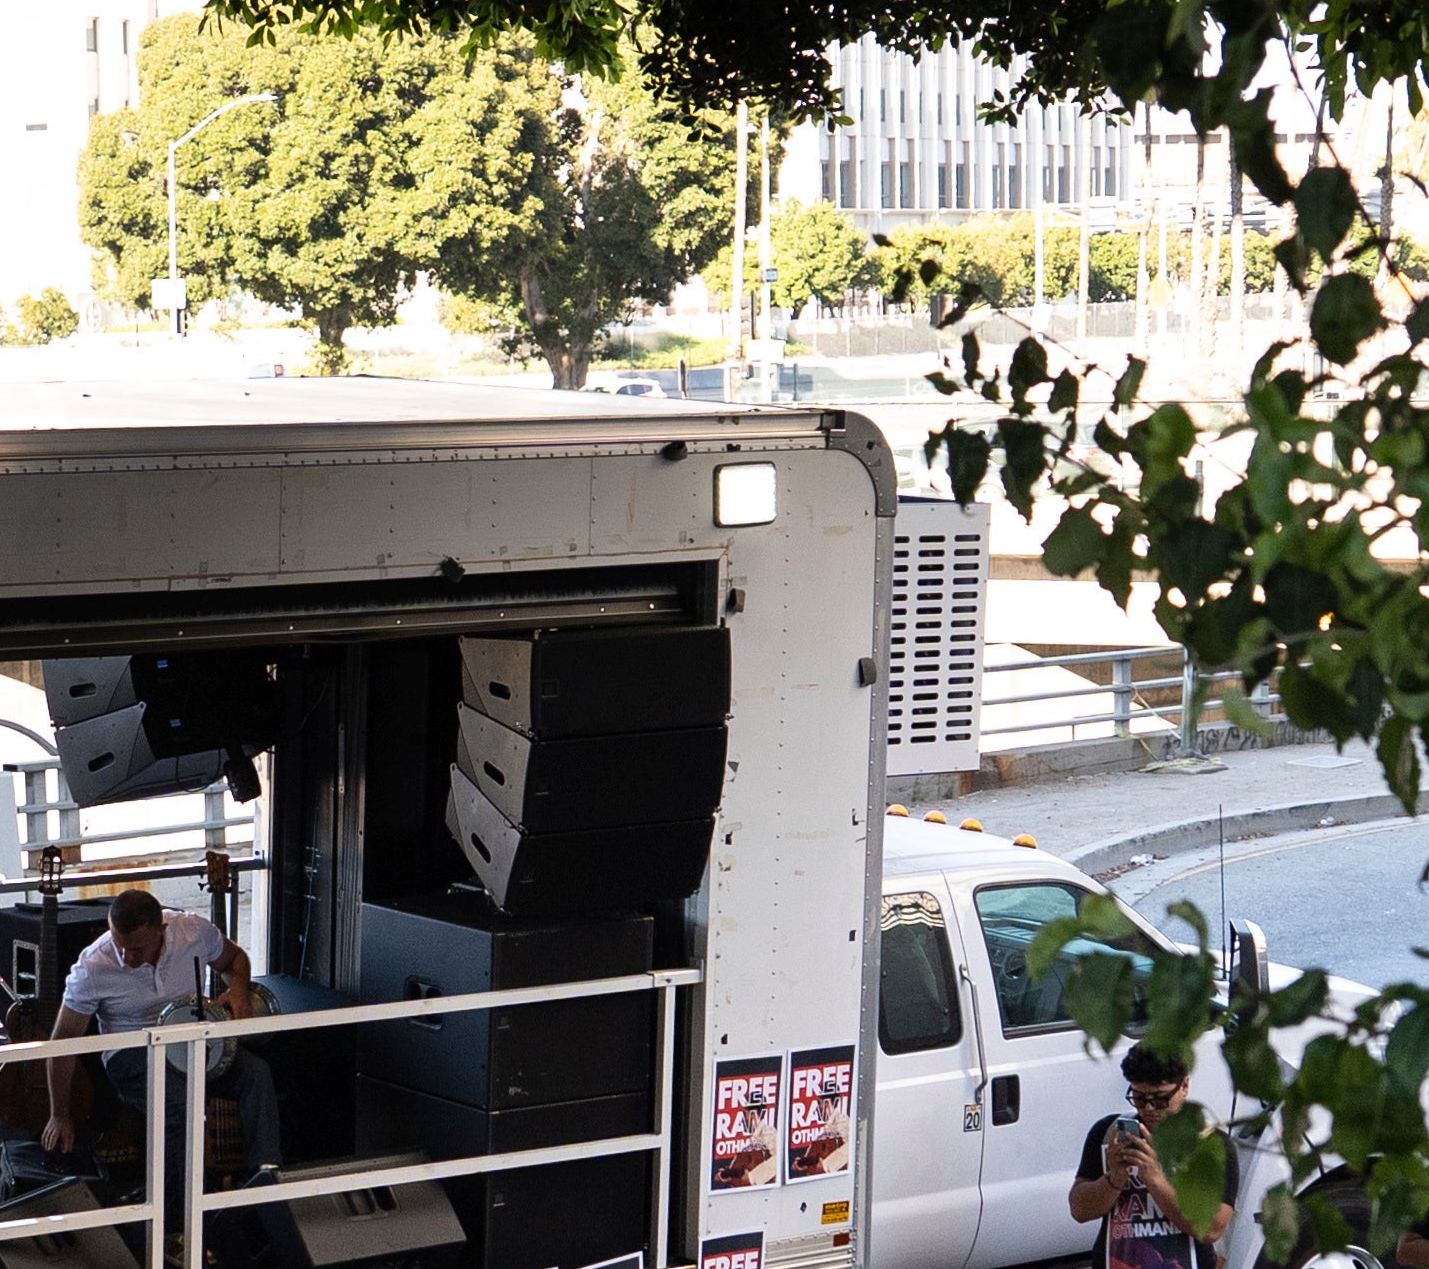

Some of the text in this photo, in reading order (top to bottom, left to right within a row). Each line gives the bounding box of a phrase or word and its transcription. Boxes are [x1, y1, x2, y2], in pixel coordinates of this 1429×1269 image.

[717, 1075, 777, 1109] FREE
[793, 1064, 850, 1099] FREE
[716, 1108, 775, 1140] RAMI
[793, 1096, 848, 1128] RAMI
[966, 1112, 981, 1130] 20
[1112, 1193, 1165, 1223] RAM
